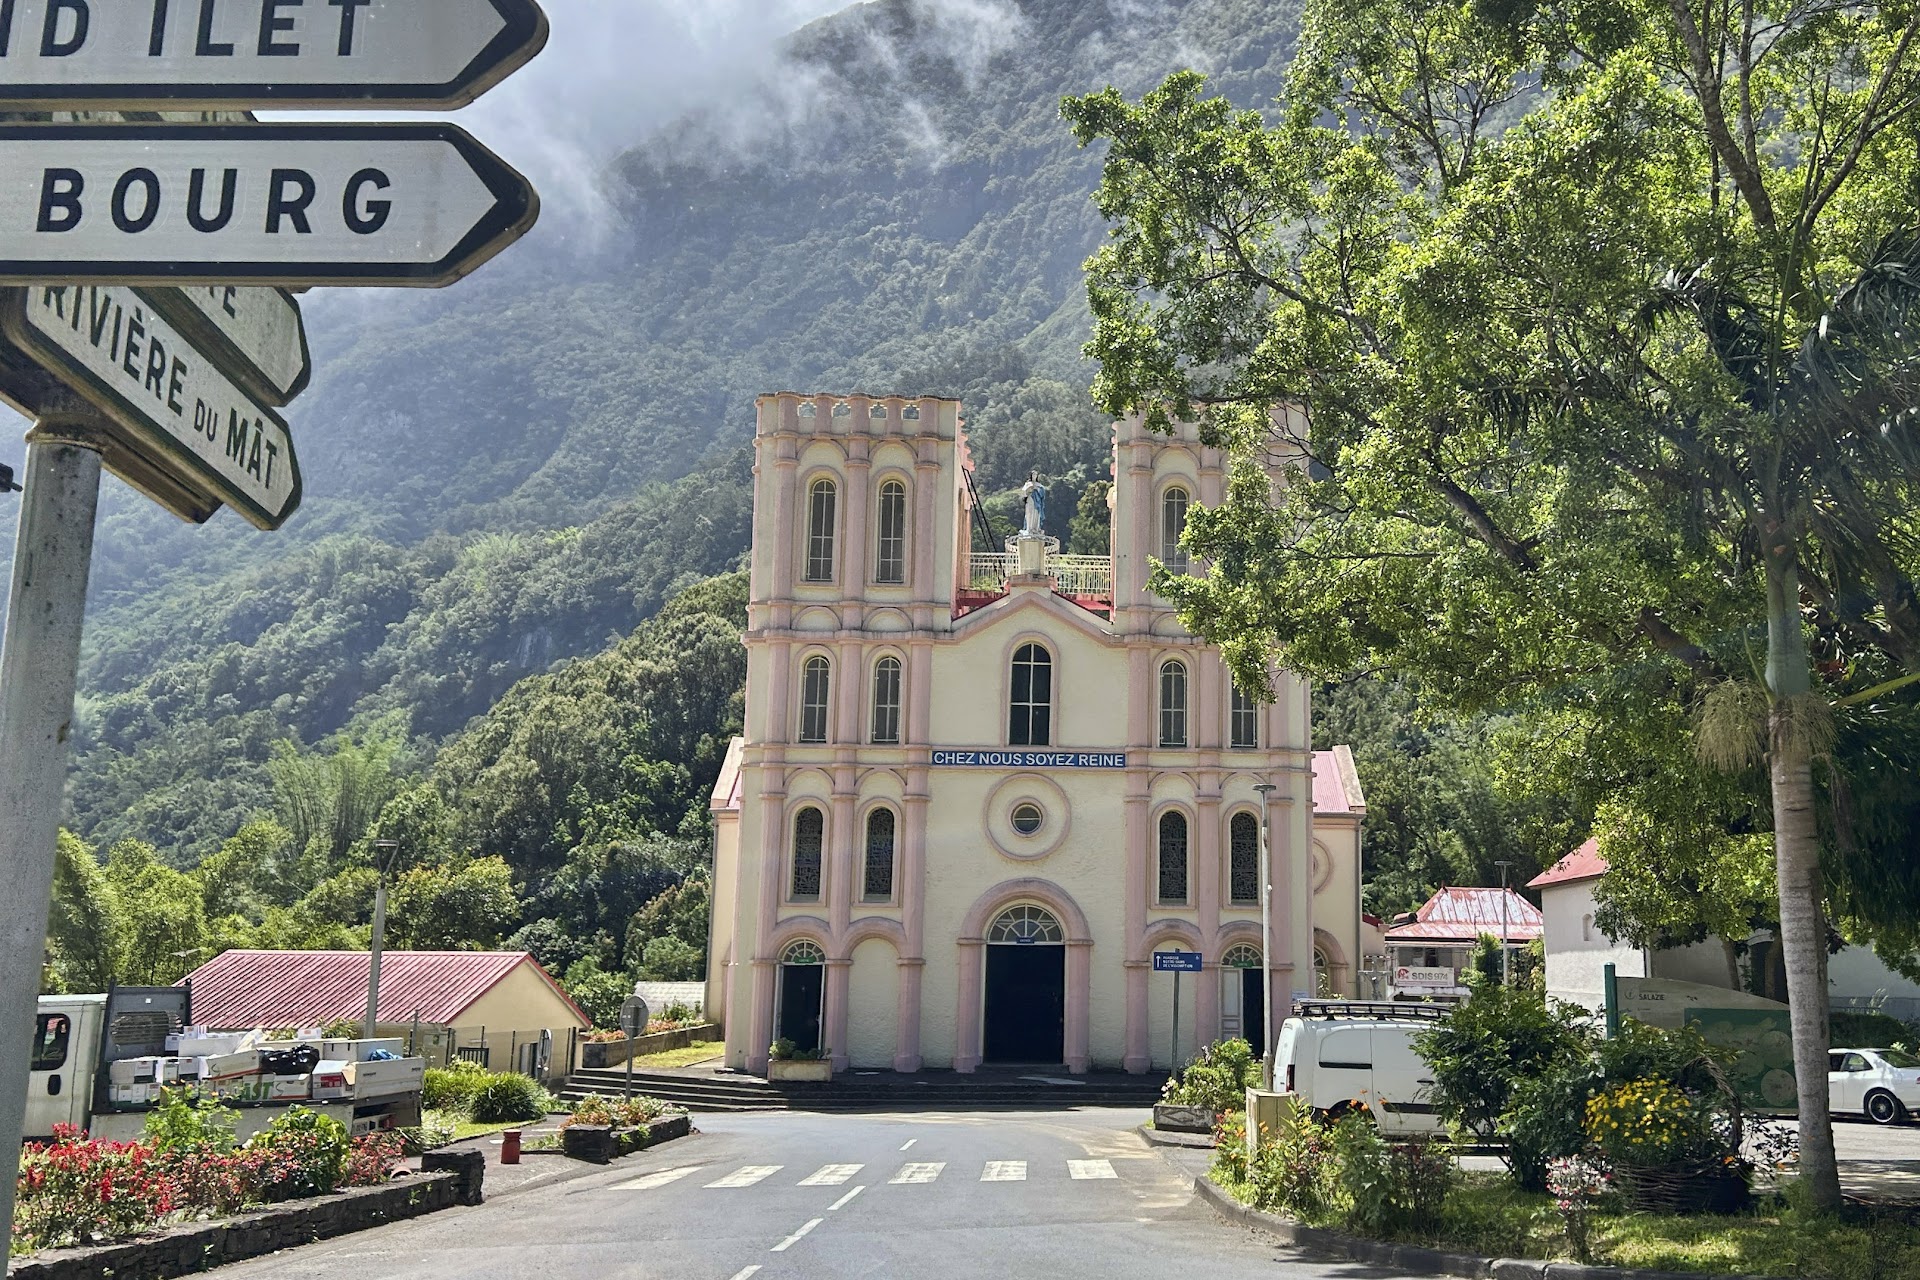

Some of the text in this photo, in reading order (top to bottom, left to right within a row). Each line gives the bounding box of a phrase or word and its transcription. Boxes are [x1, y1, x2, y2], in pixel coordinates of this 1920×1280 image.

[0, 0, 90, 57] D
[36, 167, 392, 235] BOURG
[193, 397, 218, 442] DU
[225, 407, 277, 489] MÂT
[933, 752, 1124, 767] CHEZ NOUS SOYEZ REINE
